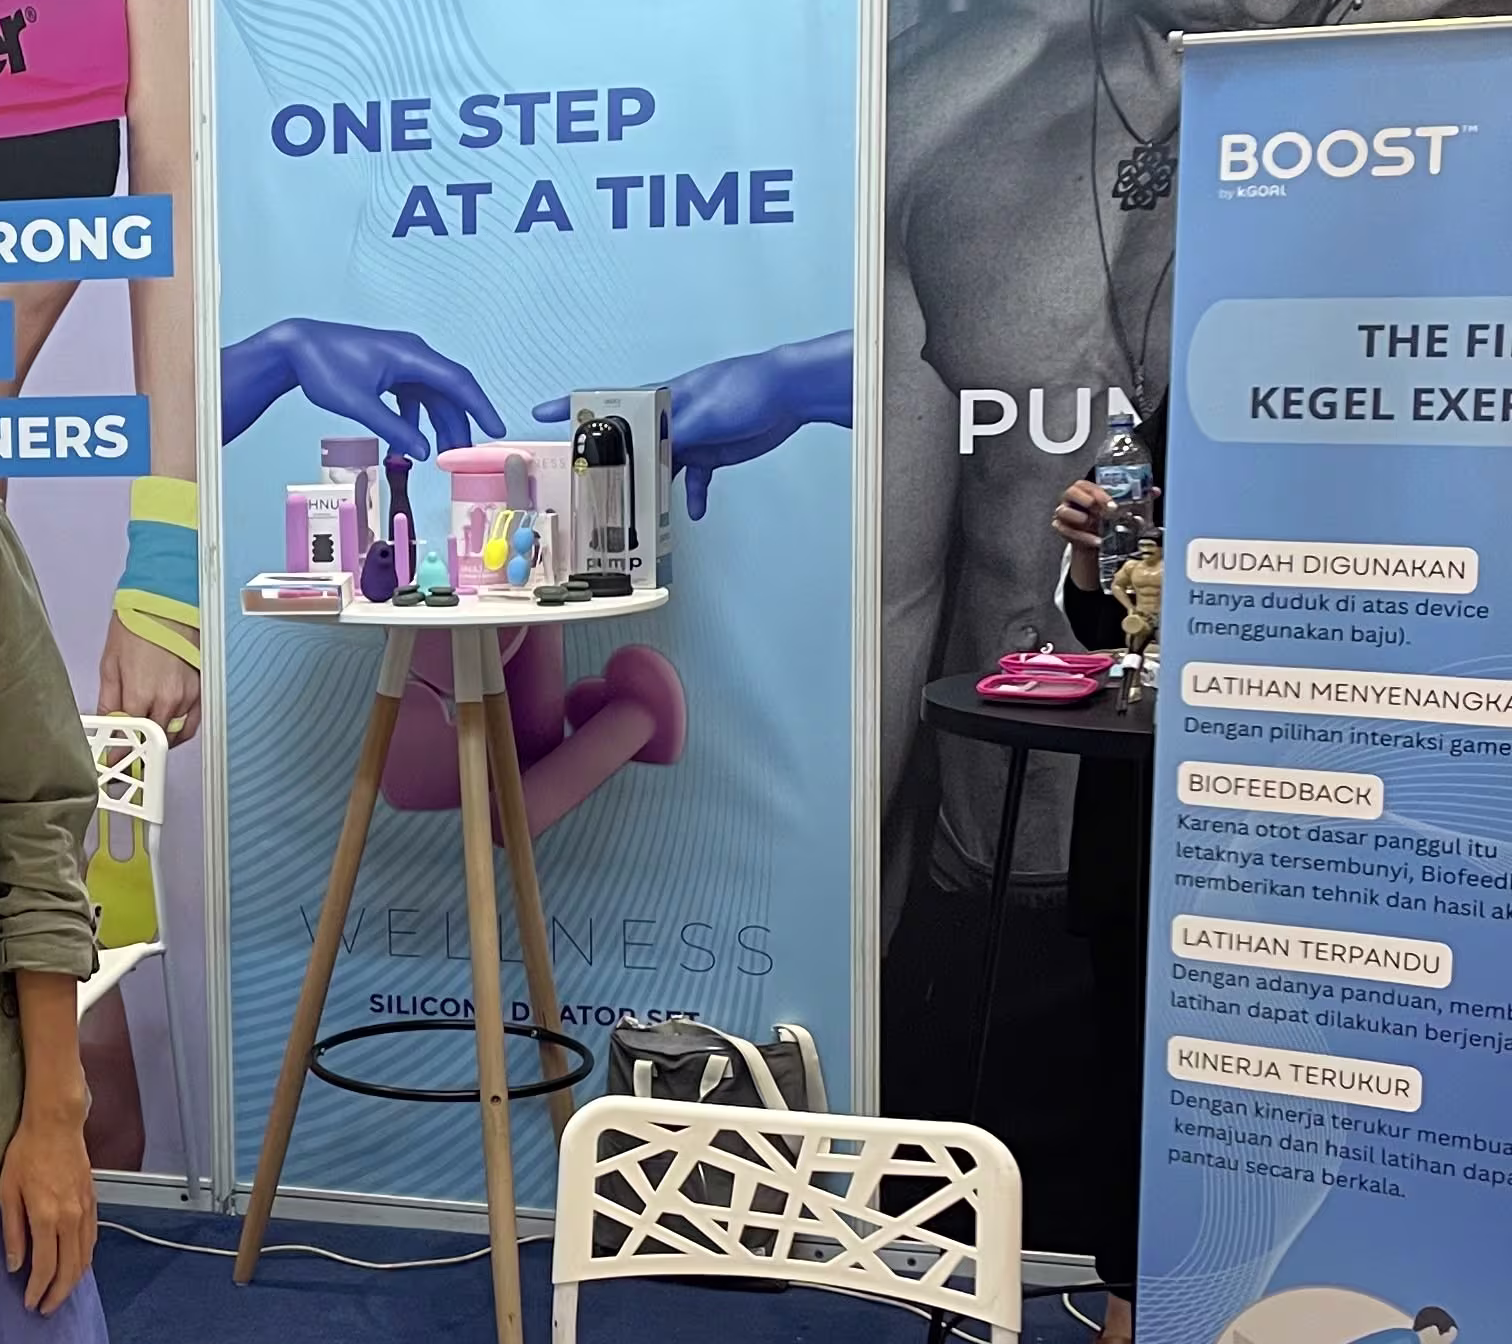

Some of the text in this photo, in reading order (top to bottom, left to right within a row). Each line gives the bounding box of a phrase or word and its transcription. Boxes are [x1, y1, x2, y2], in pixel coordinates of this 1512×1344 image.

[270, 87, 656, 157] ONE STEP
[391, 169, 795, 239] AT A TIME
[1358, 324, 1512, 358] THE FI
[1251, 386, 1395, 420] KEGEL
[308, 498, 347, 510] HNU
[1198, 551, 1466, 580] MUDAH DIGUNAKAN
[1189, 589, 1489, 619] Hanya duduk di atas device
[1187, 617, 1411, 648] (menggunakan baju).
[1192, 674, 1301, 699] LATIHAN
[1184, 717, 1512, 757] Dengan pilihan interaksi game
[1189, 773, 1373, 806] BIOFEEDBACK
[1177, 814, 1498, 859] Karena otot dasar panggul itu
[1176, 842, 1512, 890] letaknya tersembunyi, Biofeed
[1175, 871, 1306, 898] memberikan
[1312, 883, 1380, 907] tehnik
[1386, 891, 1426, 912] dan
[1433, 895, 1485, 919] hasil
[300, 904, 774, 977] WELLNESS
[1183, 927, 1441, 975] LATIHAN TERPANDU
[369, 993, 476, 1019] SILICON
[512, 1001, 637, 1027] DATOR
[1172, 963, 1250, 991] Dengan
[1256, 974, 1334, 1000] adanya
[1340, 985, 1443, 1016] panduan,
[1170, 991, 1241, 1017] latihan
[1248, 1002, 1310, 1026] dapat
[1316, 1010, 1418, 1039] dilakukan
[1178, 1049, 1411, 1098] KINERJA TERUKUR
[1170, 1089, 1248, 1116] Dengan
[1254, 1101, 1325, 1128] kinerja
[1331, 1113, 1412, 1140] terukur
[1174, 1117, 1272, 1148] kemajuan
[1279, 1133, 1318, 1155] dan
[1325, 1140, 1375, 1165] hasil
[1381, 1146, 1456, 1177] latihan
[1168, 1147, 1406, 1198] pantau secara berkala.
